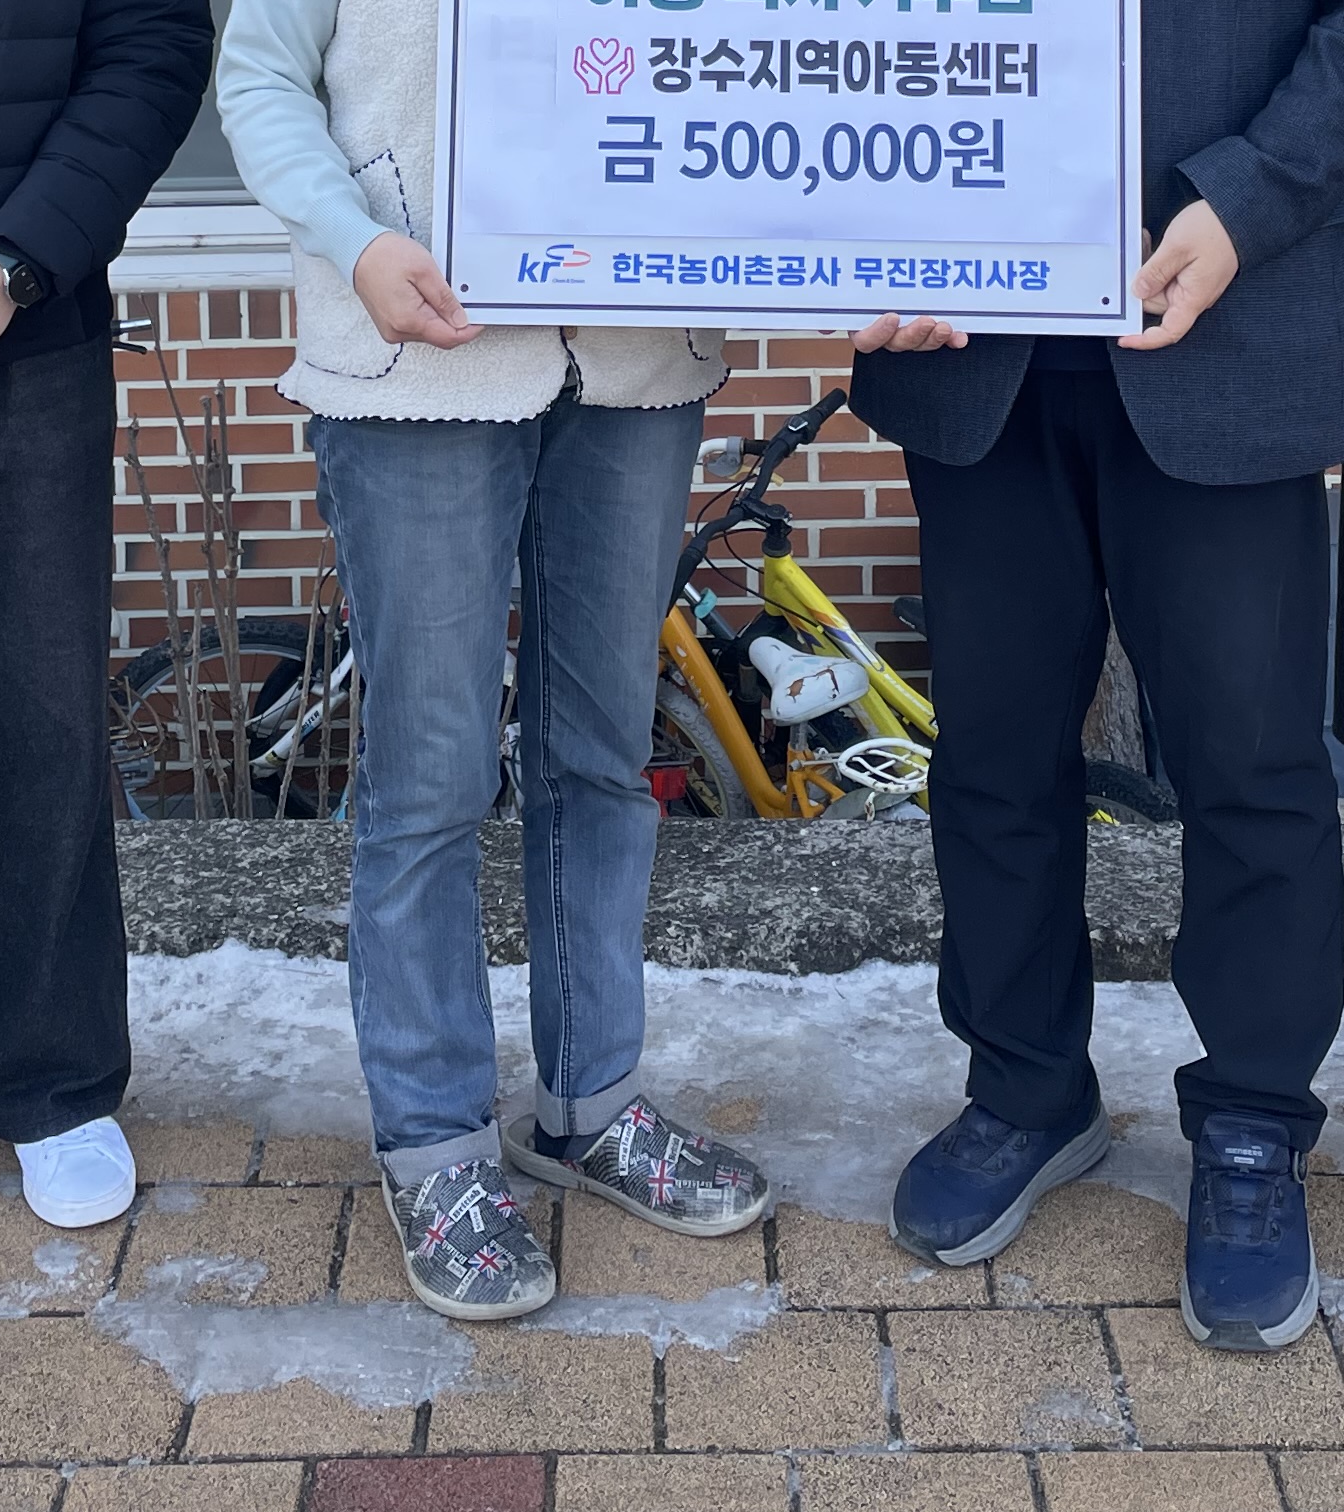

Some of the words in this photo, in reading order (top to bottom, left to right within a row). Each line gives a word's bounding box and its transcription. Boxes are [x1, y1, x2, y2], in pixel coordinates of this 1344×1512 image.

[648, 38, 1038, 98] 장수지역아동센터
[597, 115, 663, 184] 금
[679, 118, 1006, 196] 500,000원
[612, 252, 842, 287] 한국농어촌공사
[853, 257, 1051, 291] 무진장지사장
[452, 1189, 482, 1219] British
